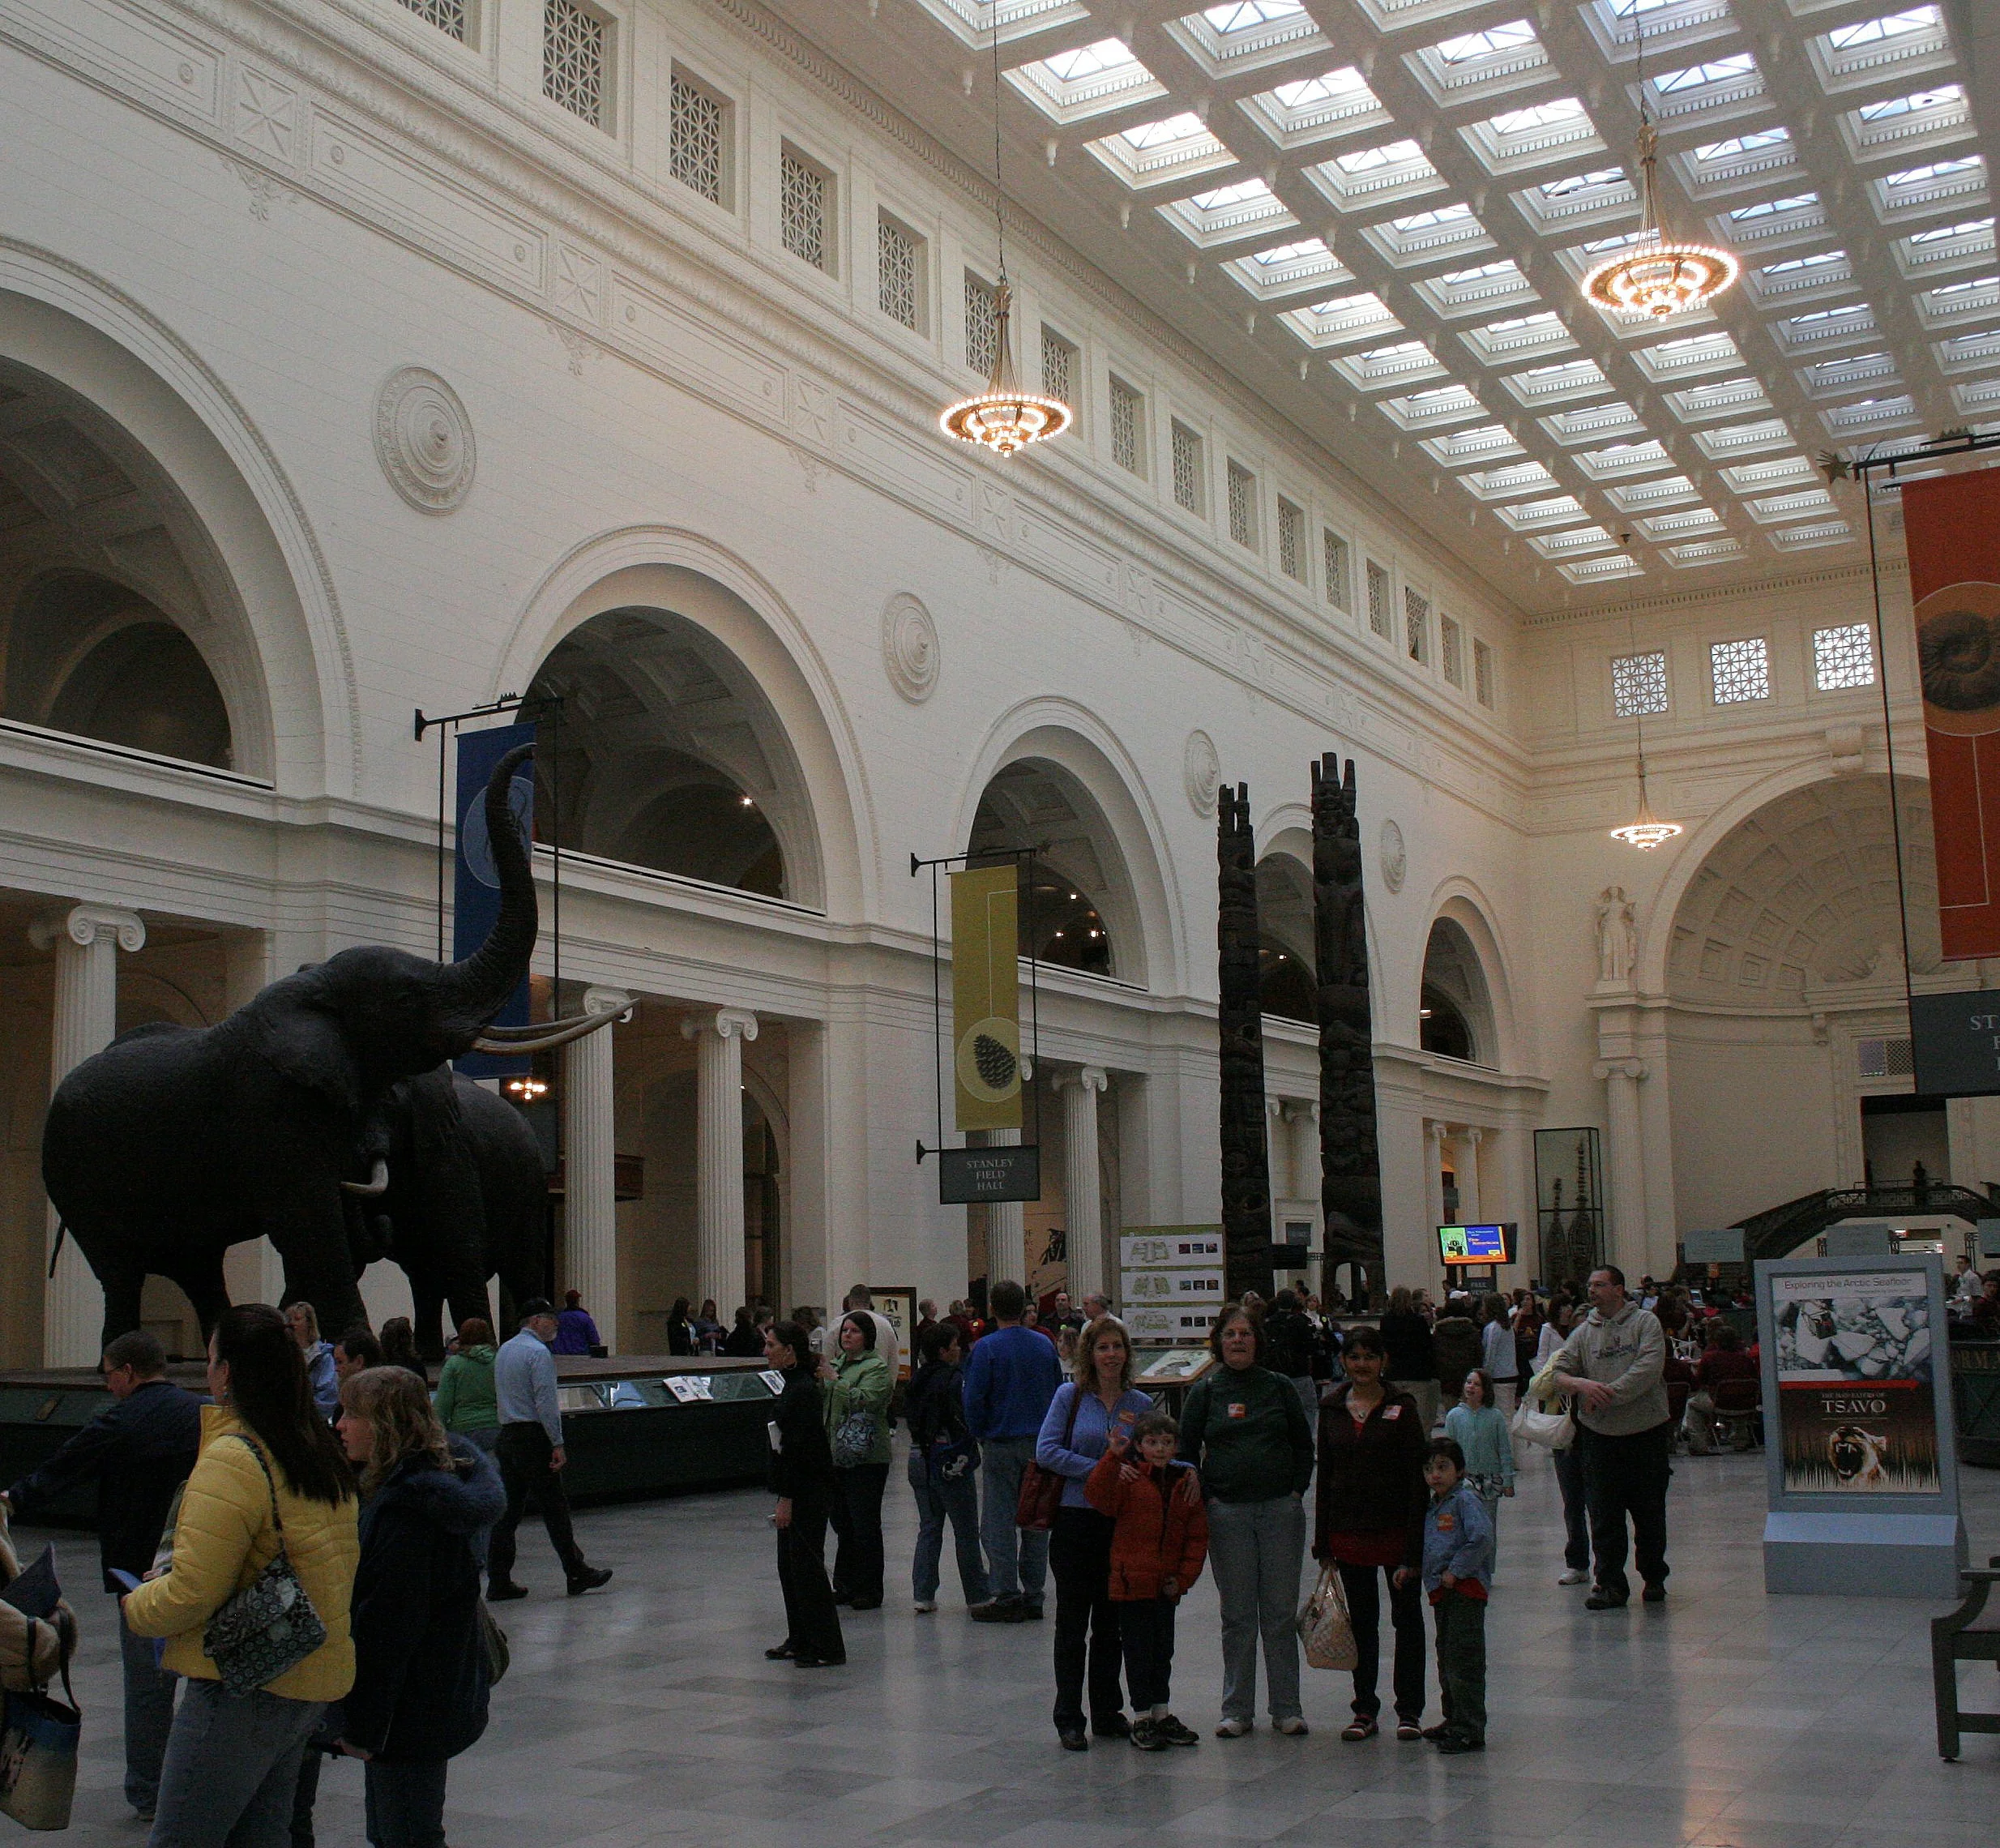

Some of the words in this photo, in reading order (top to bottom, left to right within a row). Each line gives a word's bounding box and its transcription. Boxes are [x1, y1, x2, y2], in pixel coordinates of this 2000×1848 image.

[966, 1158, 1014, 1170] STANLEY
[976, 1170, 1006, 1180] FIELD
[977, 1181, 1005, 1191] HALL
[1784, 1280, 1825, 1290] Exploring
[1827, 1279, 1843, 1287] the
[1844, 1278, 1870, 1287] Arctic
[1873, 1277, 1912, 1286] Seafloor
[1821, 1399, 1887, 1413] TSAVO
